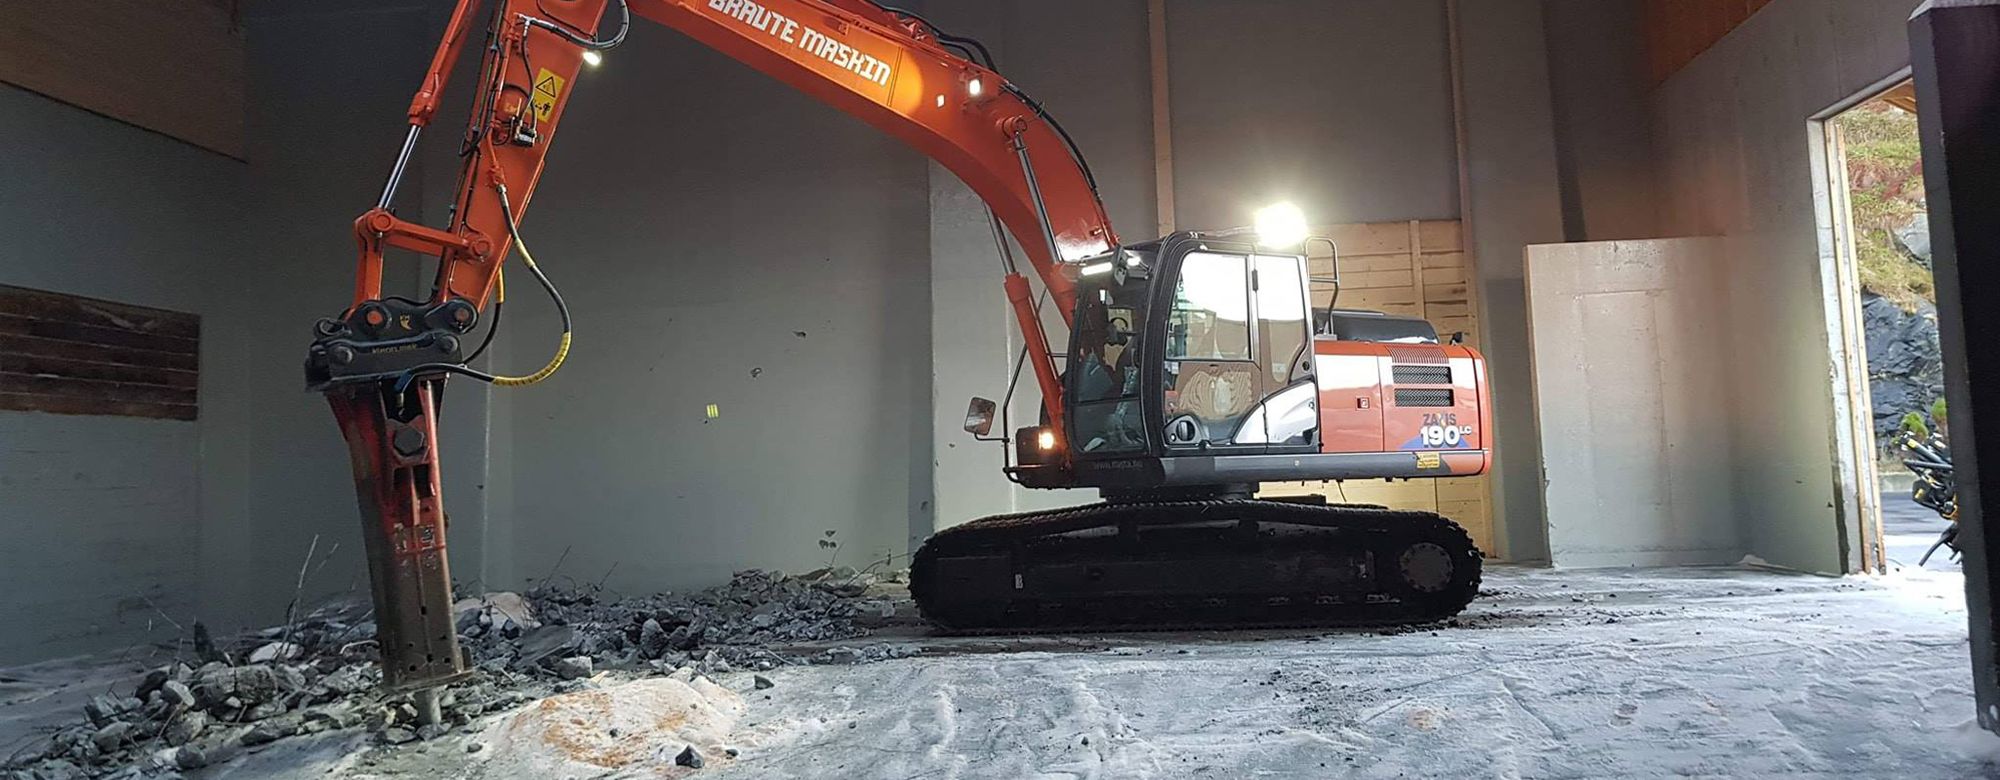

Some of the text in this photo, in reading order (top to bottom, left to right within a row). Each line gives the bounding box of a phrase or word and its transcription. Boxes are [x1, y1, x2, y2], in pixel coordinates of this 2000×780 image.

[798, 26, 891, 86] MASKIN
[1420, 425, 1472, 448] 190 LC
